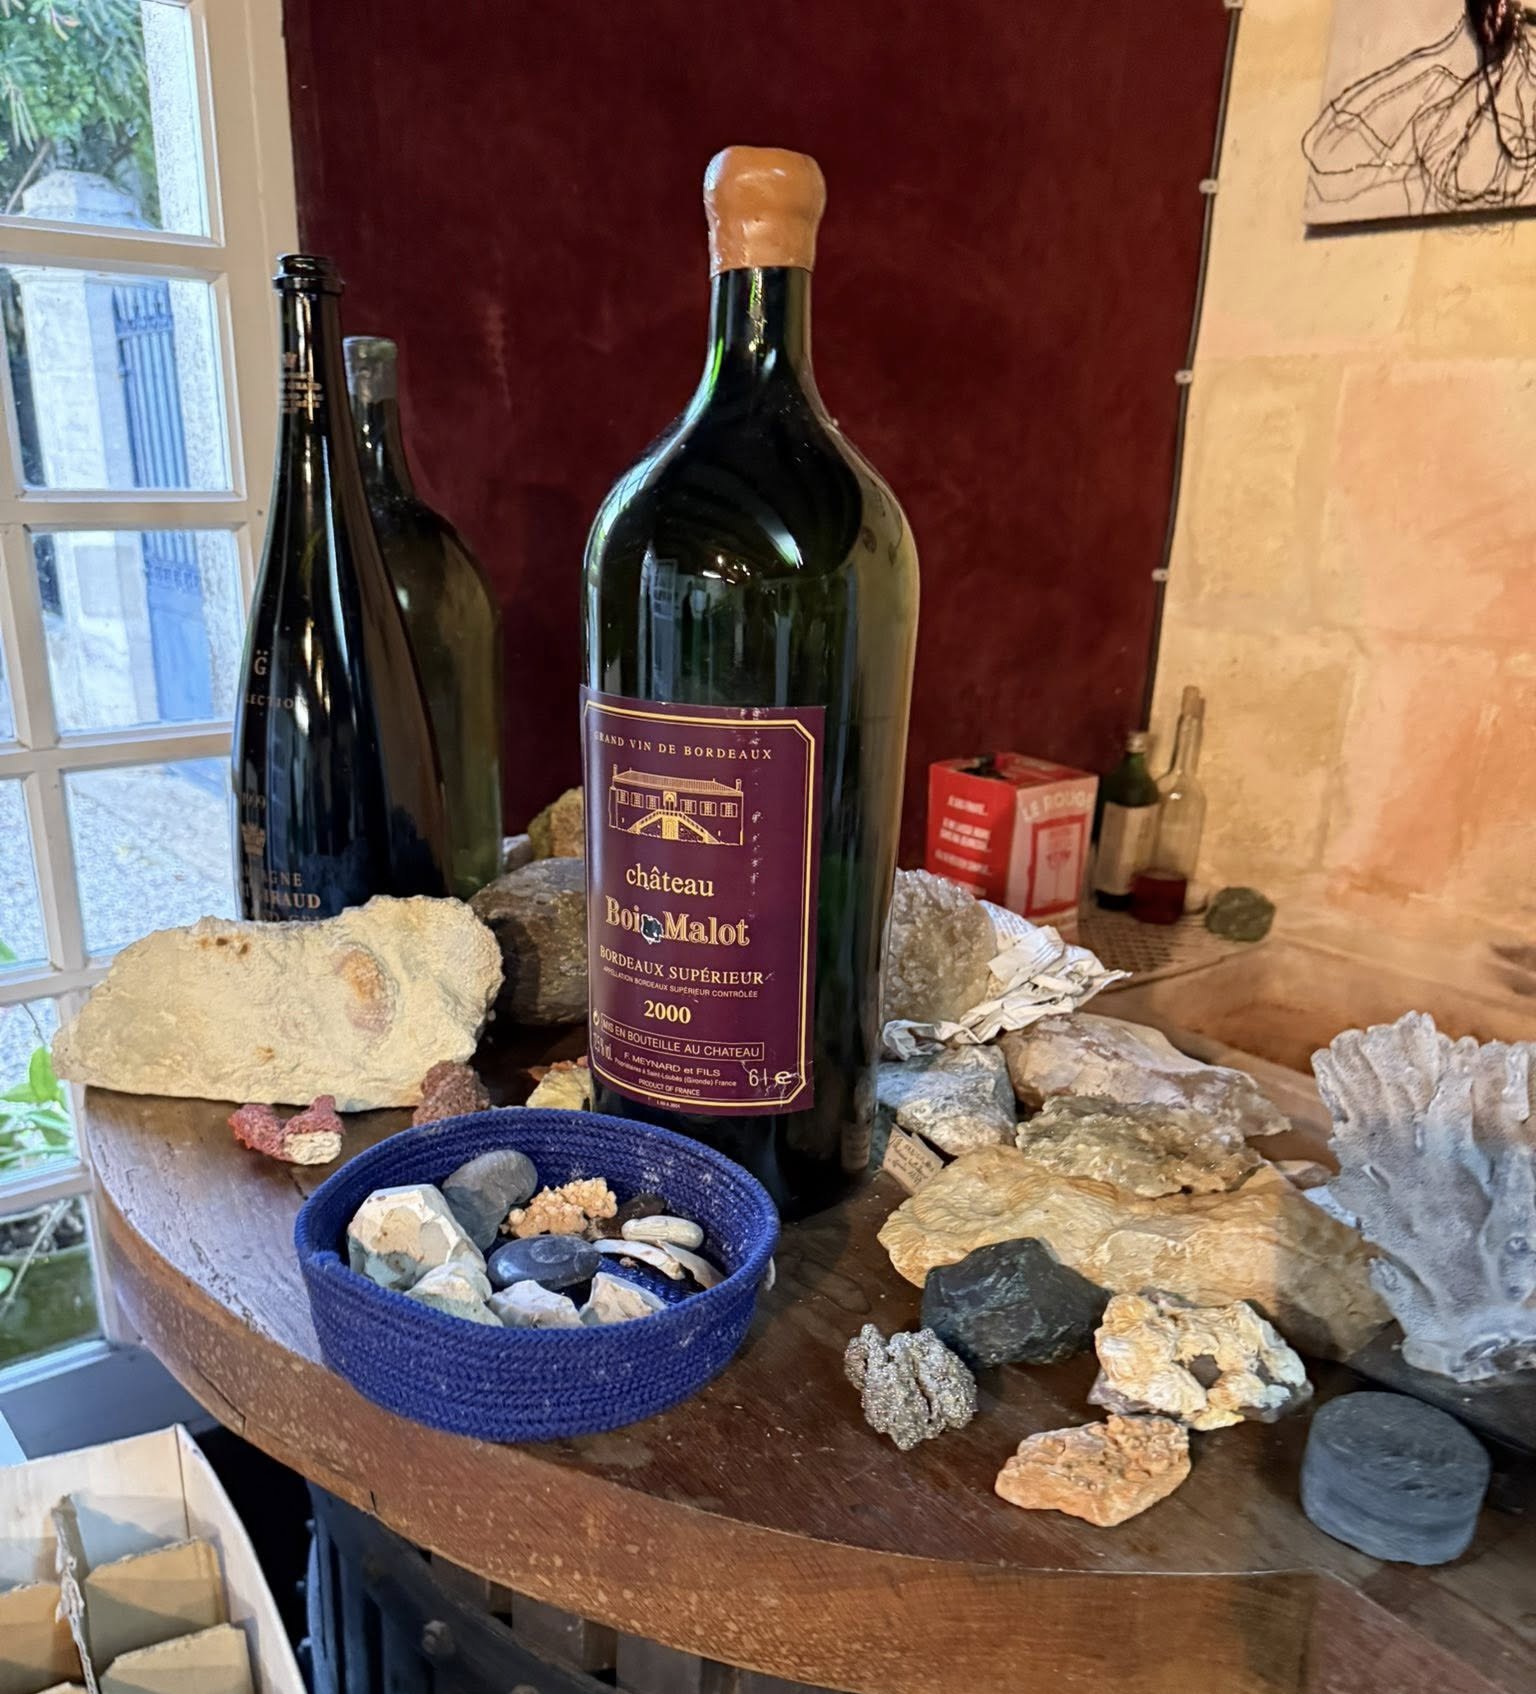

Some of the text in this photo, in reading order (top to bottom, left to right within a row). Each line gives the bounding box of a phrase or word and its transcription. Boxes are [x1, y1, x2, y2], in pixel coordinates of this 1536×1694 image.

[593, 730, 772, 760] GRAND VIN DE BORDEAUX
[626, 863, 714, 897] château
[605, 896, 750, 946] Boi Malot
[600, 944, 764, 985] BORDEAUX SUPÉRIEUR
[634, 977, 668, 991] BORDEAUX
[669, 983, 710, 997] SUPÉRIEUR
[711, 988, 758, 998] CONTRÔLÉE
[644, 1000, 691, 1024] 2000
[602, 1018, 614, 1032] MIS
[615, 1025, 625, 1039] EN
[627, 1031, 681, 1053] BOUTEILLE
[684, 1044, 700, 1056] AU
[703, 1045, 759, 1058] CHATEAU
[632, 1055, 681, 1072] MEYNARD
[683, 1065, 693, 1075] et
[696, 1067, 721, 1077] FILS
[639, 1078, 701, 1097] PRODUCT OF FRANCE
[714, 1078, 737, 1087] France
